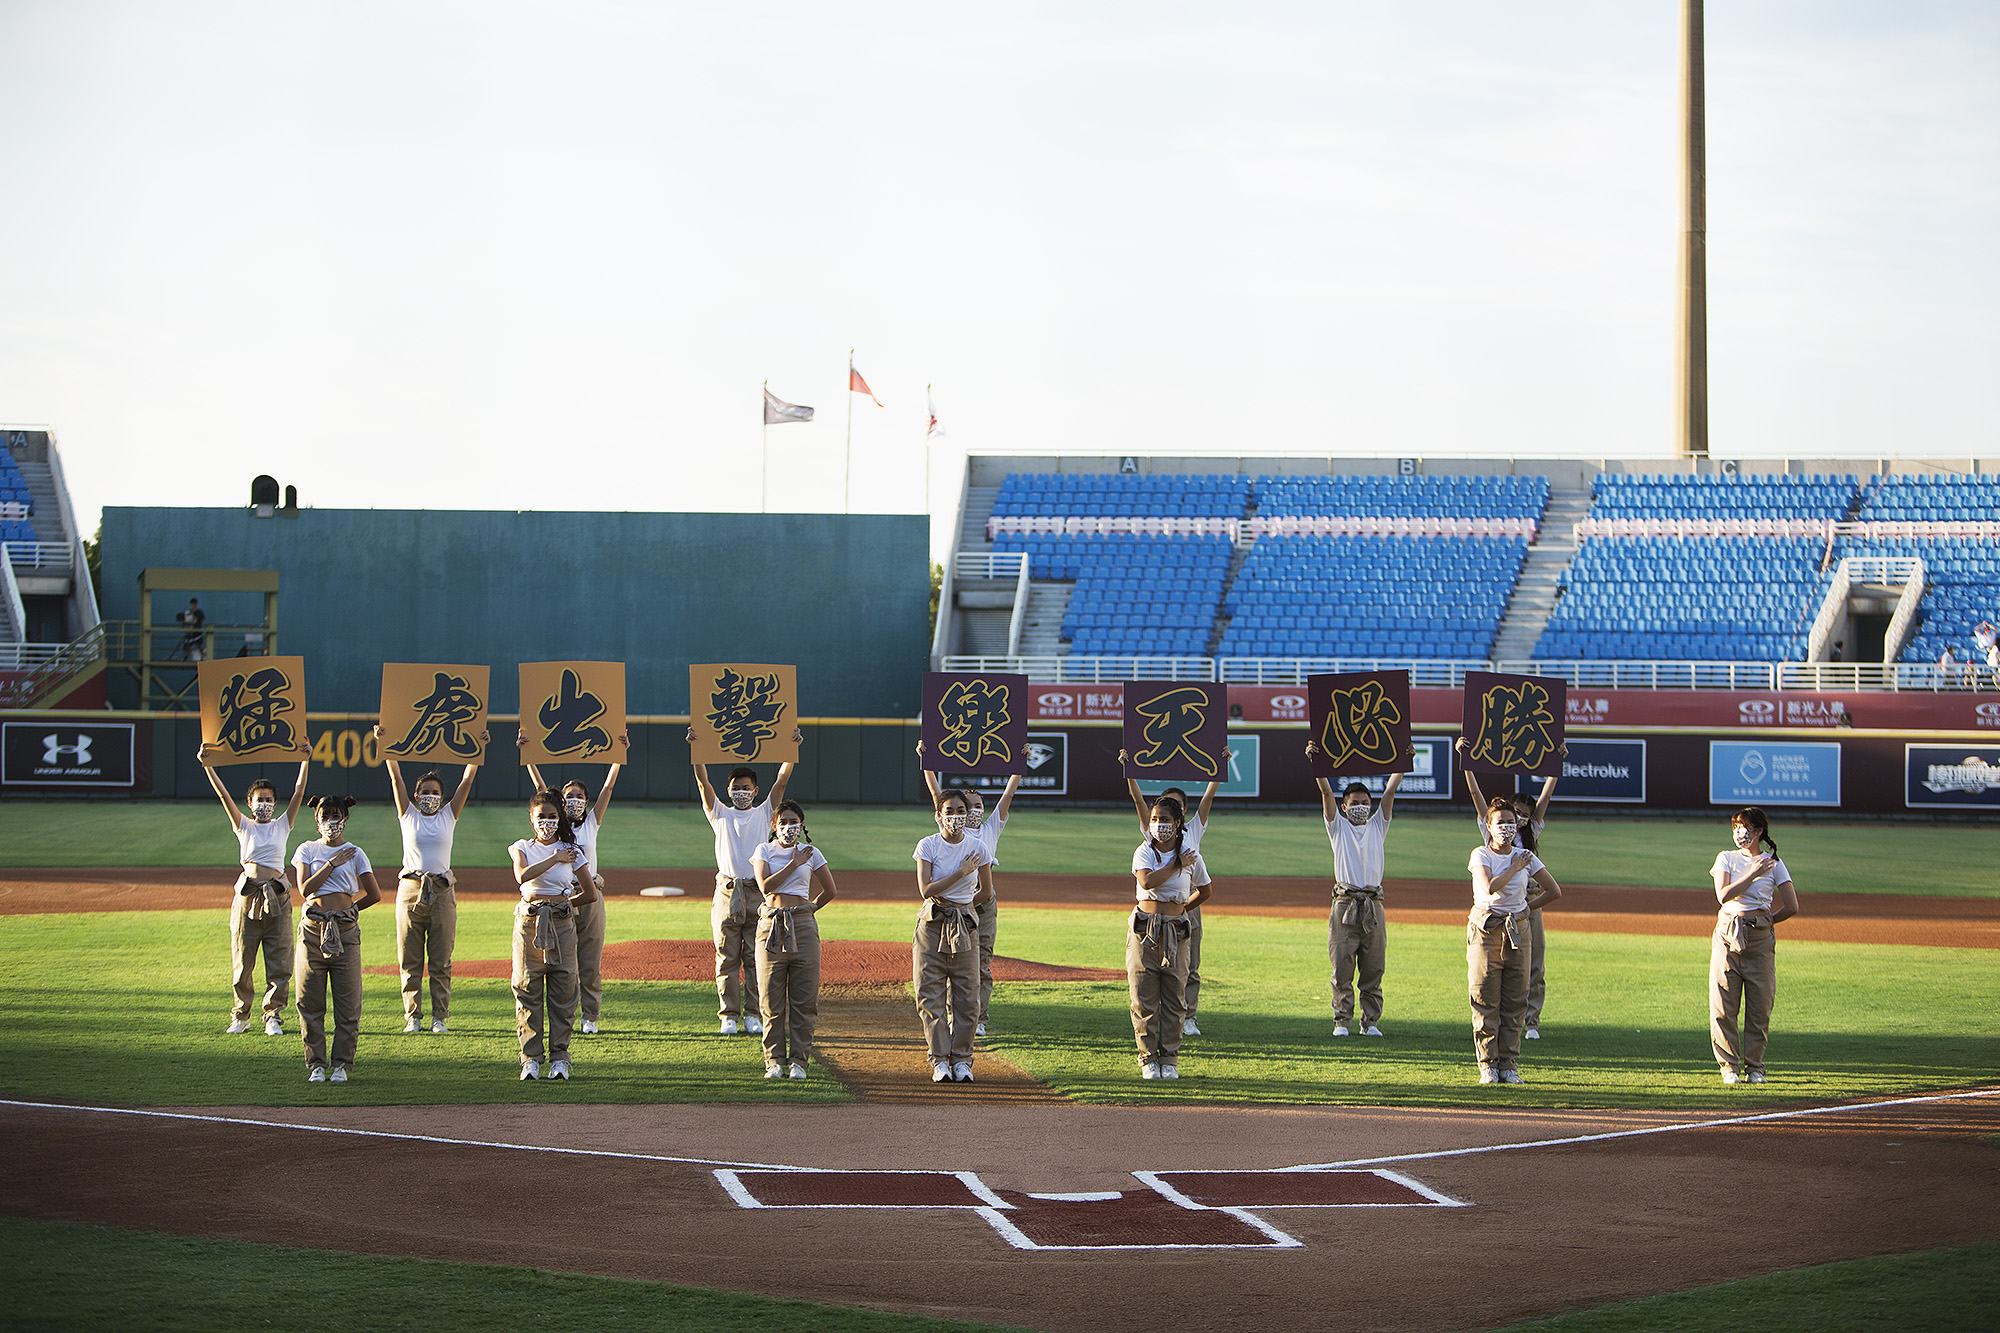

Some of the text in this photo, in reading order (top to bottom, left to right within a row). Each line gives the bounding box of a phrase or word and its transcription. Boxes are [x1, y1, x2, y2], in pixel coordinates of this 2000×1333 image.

[1121, 458, 1137, 473] A
[1400, 459, 1415, 475] B
[1721, 460, 1737, 476] C
[216, 666, 297, 756] 猛
[311, 729, 383, 768] 400
[384, 671, 483, 758] 虎
[537, 667, 613, 758] 出
[1134, 687, 1218, 777] 天
[1321, 679, 1401, 769] 必
[1470, 681, 1555, 770] 勝
[1562, 761, 1630, 779] Electrolux
